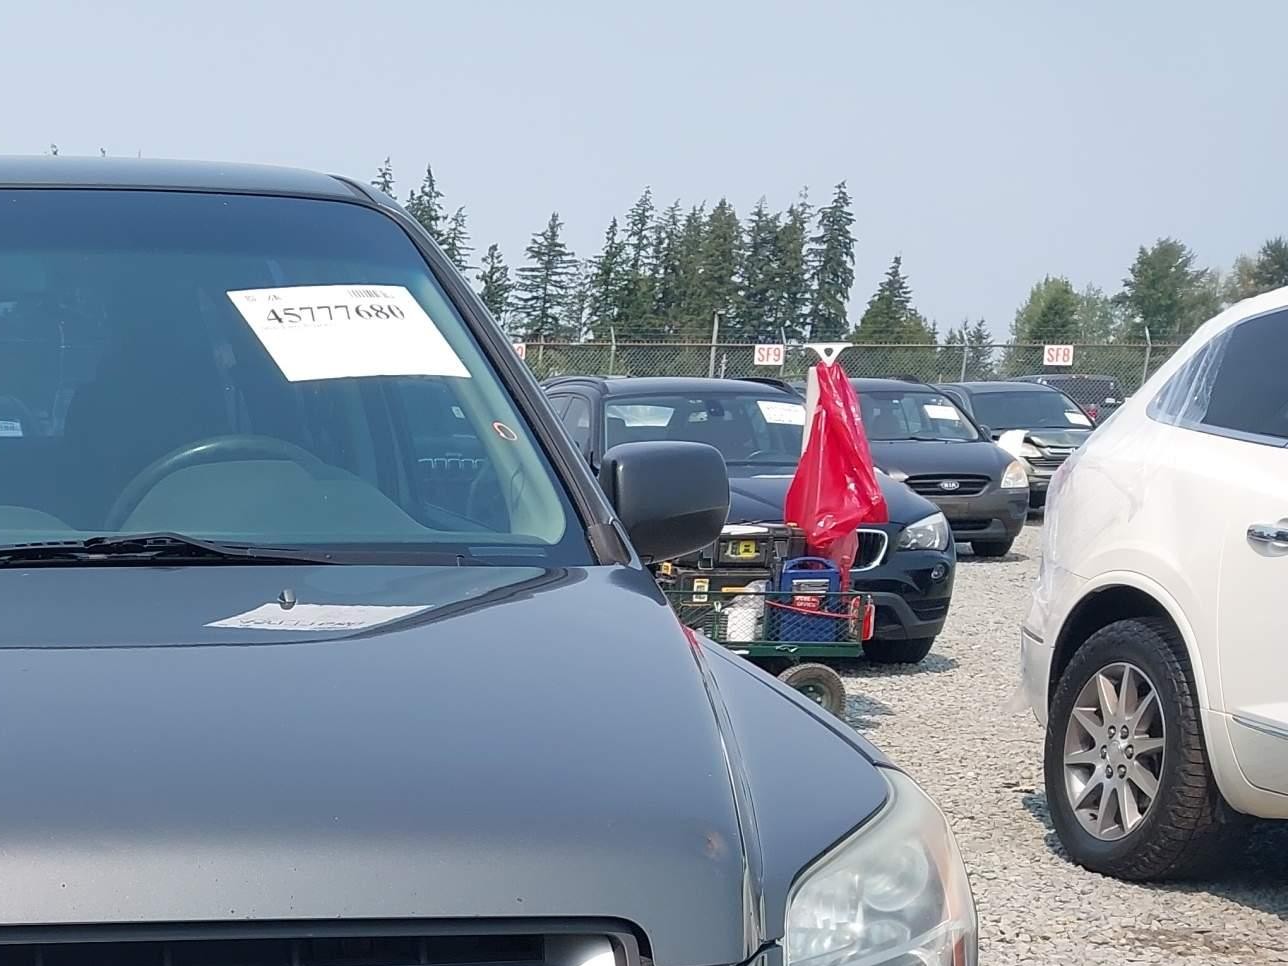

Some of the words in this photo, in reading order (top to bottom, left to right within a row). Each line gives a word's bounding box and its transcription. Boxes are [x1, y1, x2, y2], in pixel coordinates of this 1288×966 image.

[266, 303, 405, 324] 45777680
[757, 347, 781, 362] SF9
[1047, 347, 1070, 363] SF8
